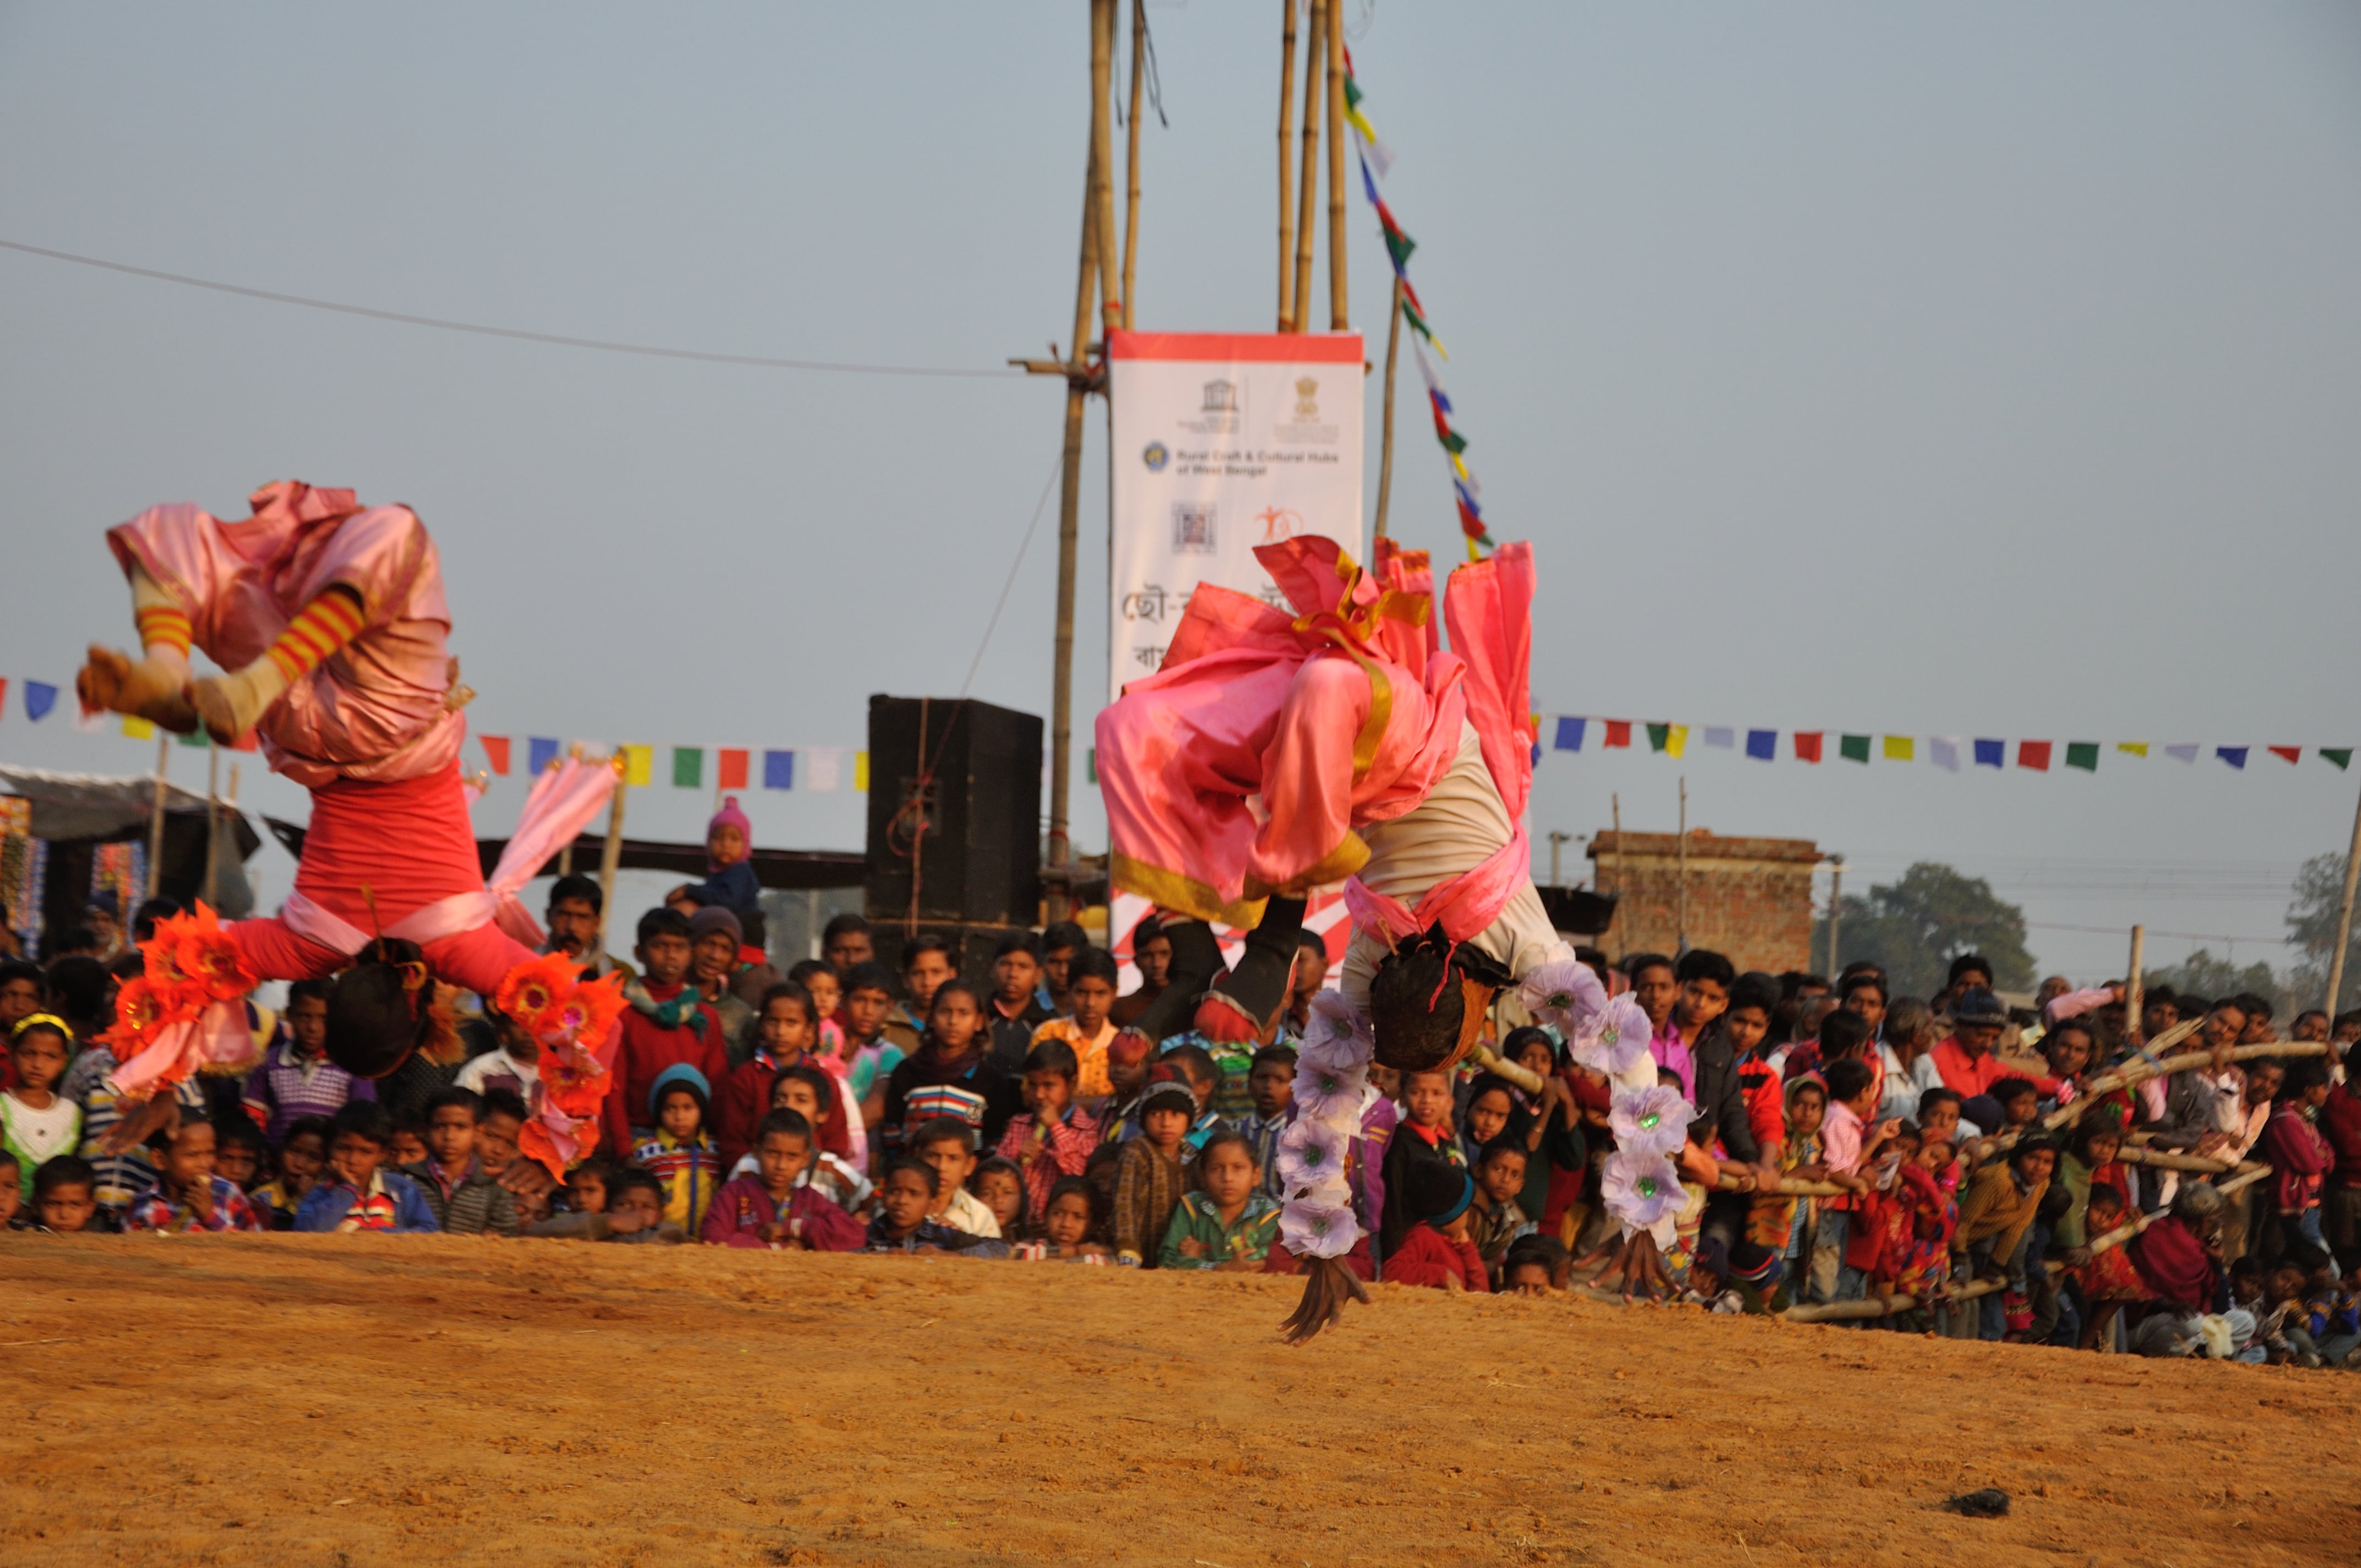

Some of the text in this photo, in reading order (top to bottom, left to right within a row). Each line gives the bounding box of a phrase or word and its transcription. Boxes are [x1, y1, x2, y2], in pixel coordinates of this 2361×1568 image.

[1177, 449, 1339, 464] Rural Craft & Cultural Hubs
[1176, 465, 1267, 478] of West Bengal
